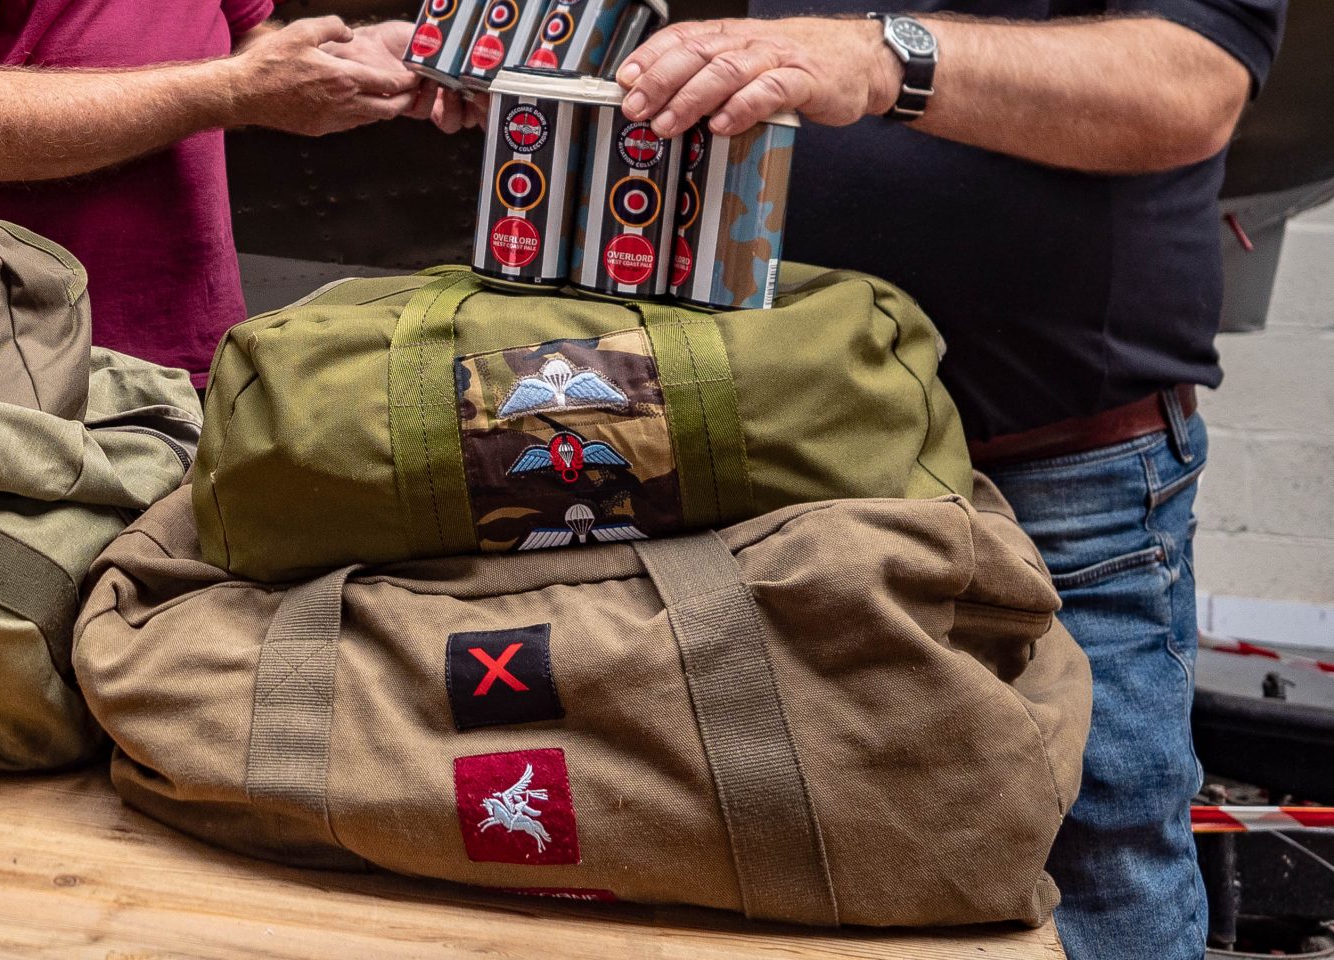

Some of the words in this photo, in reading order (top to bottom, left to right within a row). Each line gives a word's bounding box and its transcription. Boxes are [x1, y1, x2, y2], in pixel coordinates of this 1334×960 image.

[507, 107, 533, 121] BOSCOMBE
[533, 109, 547, 125] DOWN
[504, 126, 518, 150] AVIATION
[519, 131, 548, 152] COLLECTION
[618, 142, 635, 166] AVIATION
[635, 146, 665, 168] COLLECTION
[493, 233, 537, 246] OVERLORD
[607, 250, 653, 263] OVERLORD
[468, 643, 530, 696] X
